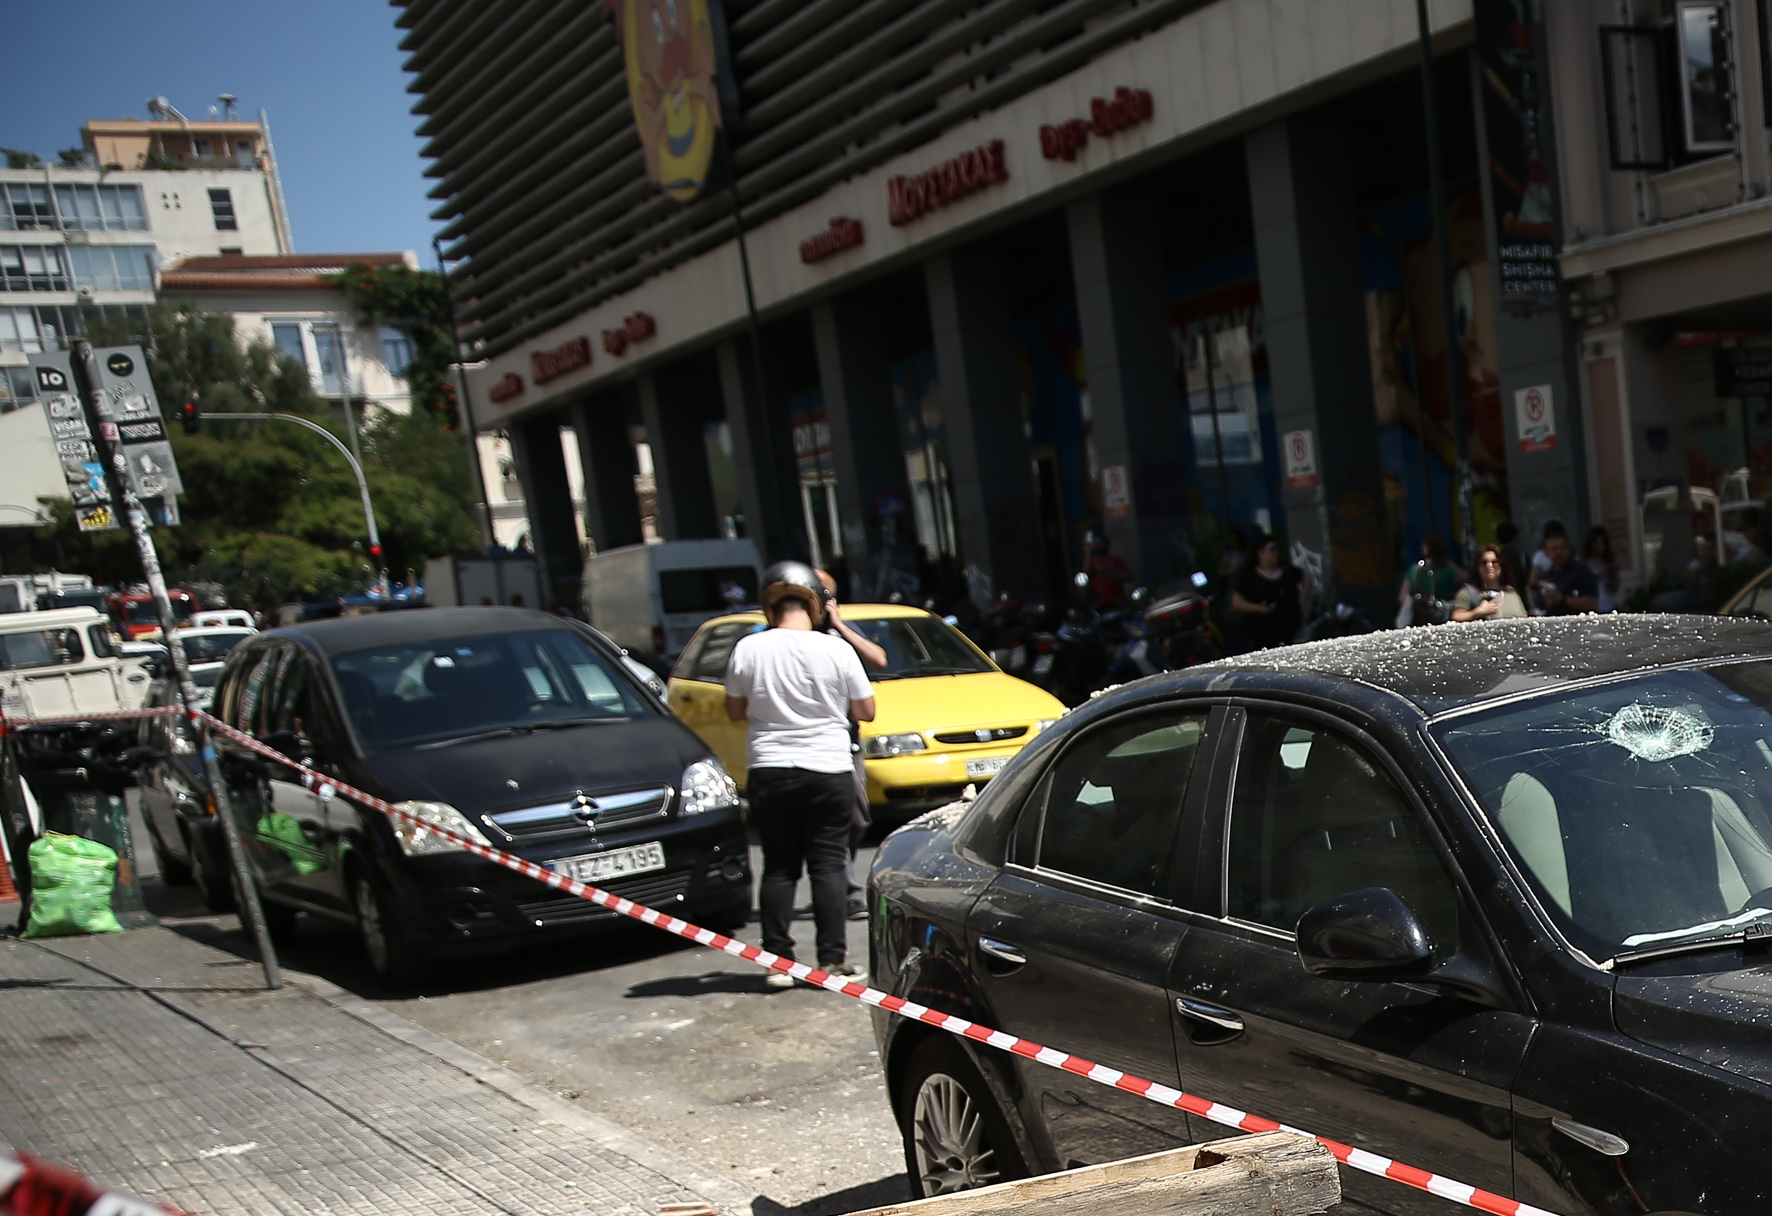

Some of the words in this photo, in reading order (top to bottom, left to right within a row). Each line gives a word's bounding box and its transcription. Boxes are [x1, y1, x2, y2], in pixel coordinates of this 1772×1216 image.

[1501, 244, 1553, 258] MISAFIR
[1502, 262, 1555, 277] SHISHA
[1504, 280, 1557, 292] CENTER
